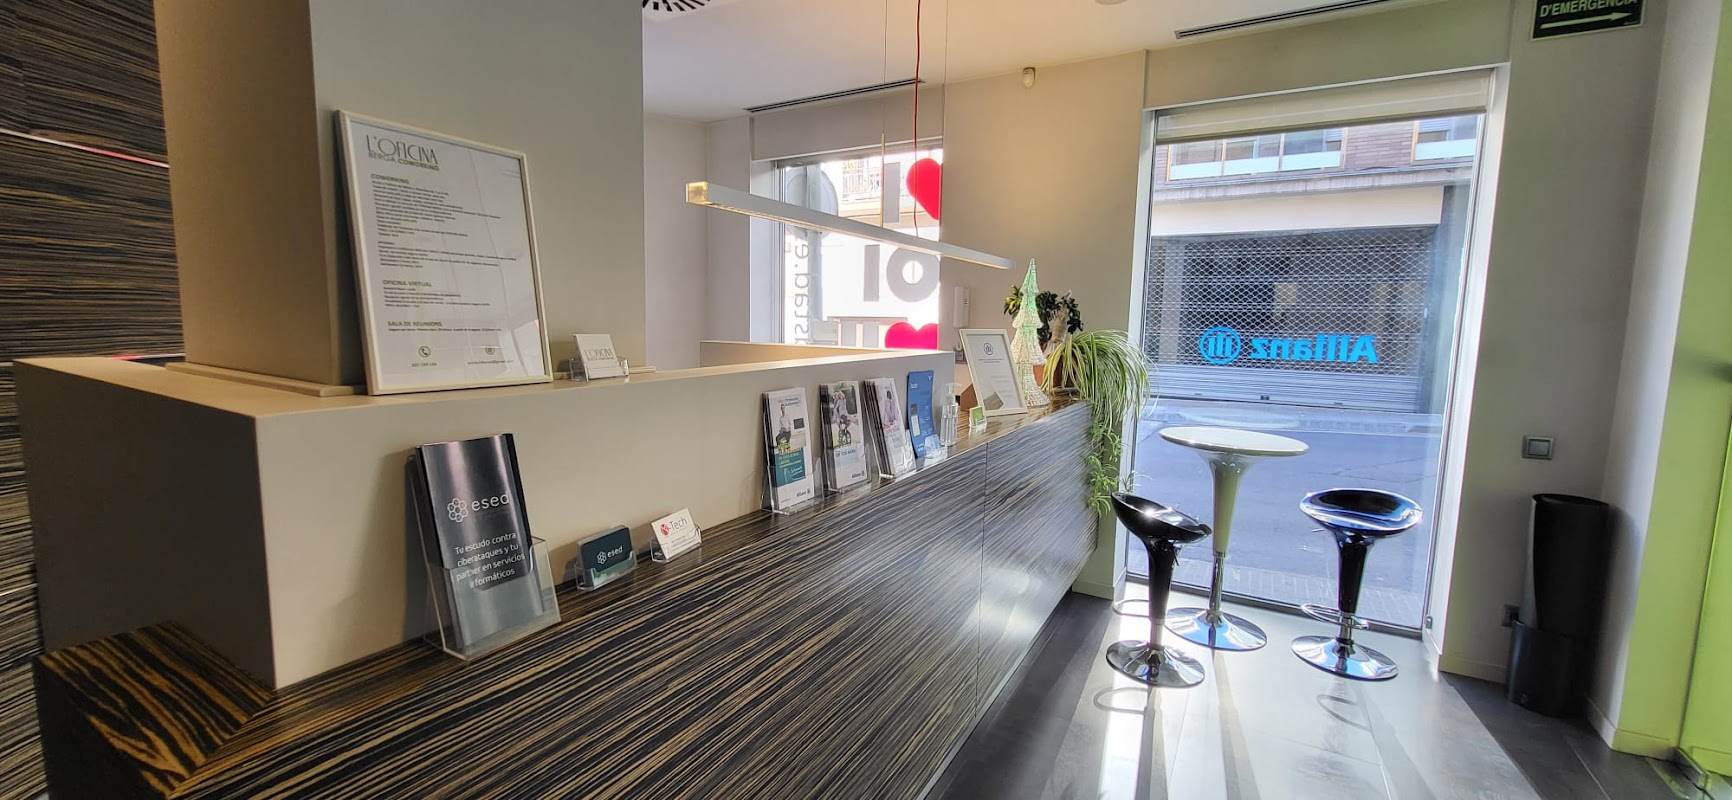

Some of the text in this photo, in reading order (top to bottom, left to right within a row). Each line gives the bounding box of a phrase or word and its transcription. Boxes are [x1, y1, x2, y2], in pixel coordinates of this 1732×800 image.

[1539, 0, 1637, 18] D'EMERGEN
[366, 134, 438, 165] L'OFICINA
[398, 158, 439, 171] COWORKING
[371, 173, 409, 184] COWORKING
[471, 490, 510, 511] esed
[455, 532, 517, 555] Tu escudo contra
[510, 543, 519, 551] tu
[607, 545, 623, 558] esed
[482, 562, 492, 572] en
[493, 553, 525, 569] servicios
